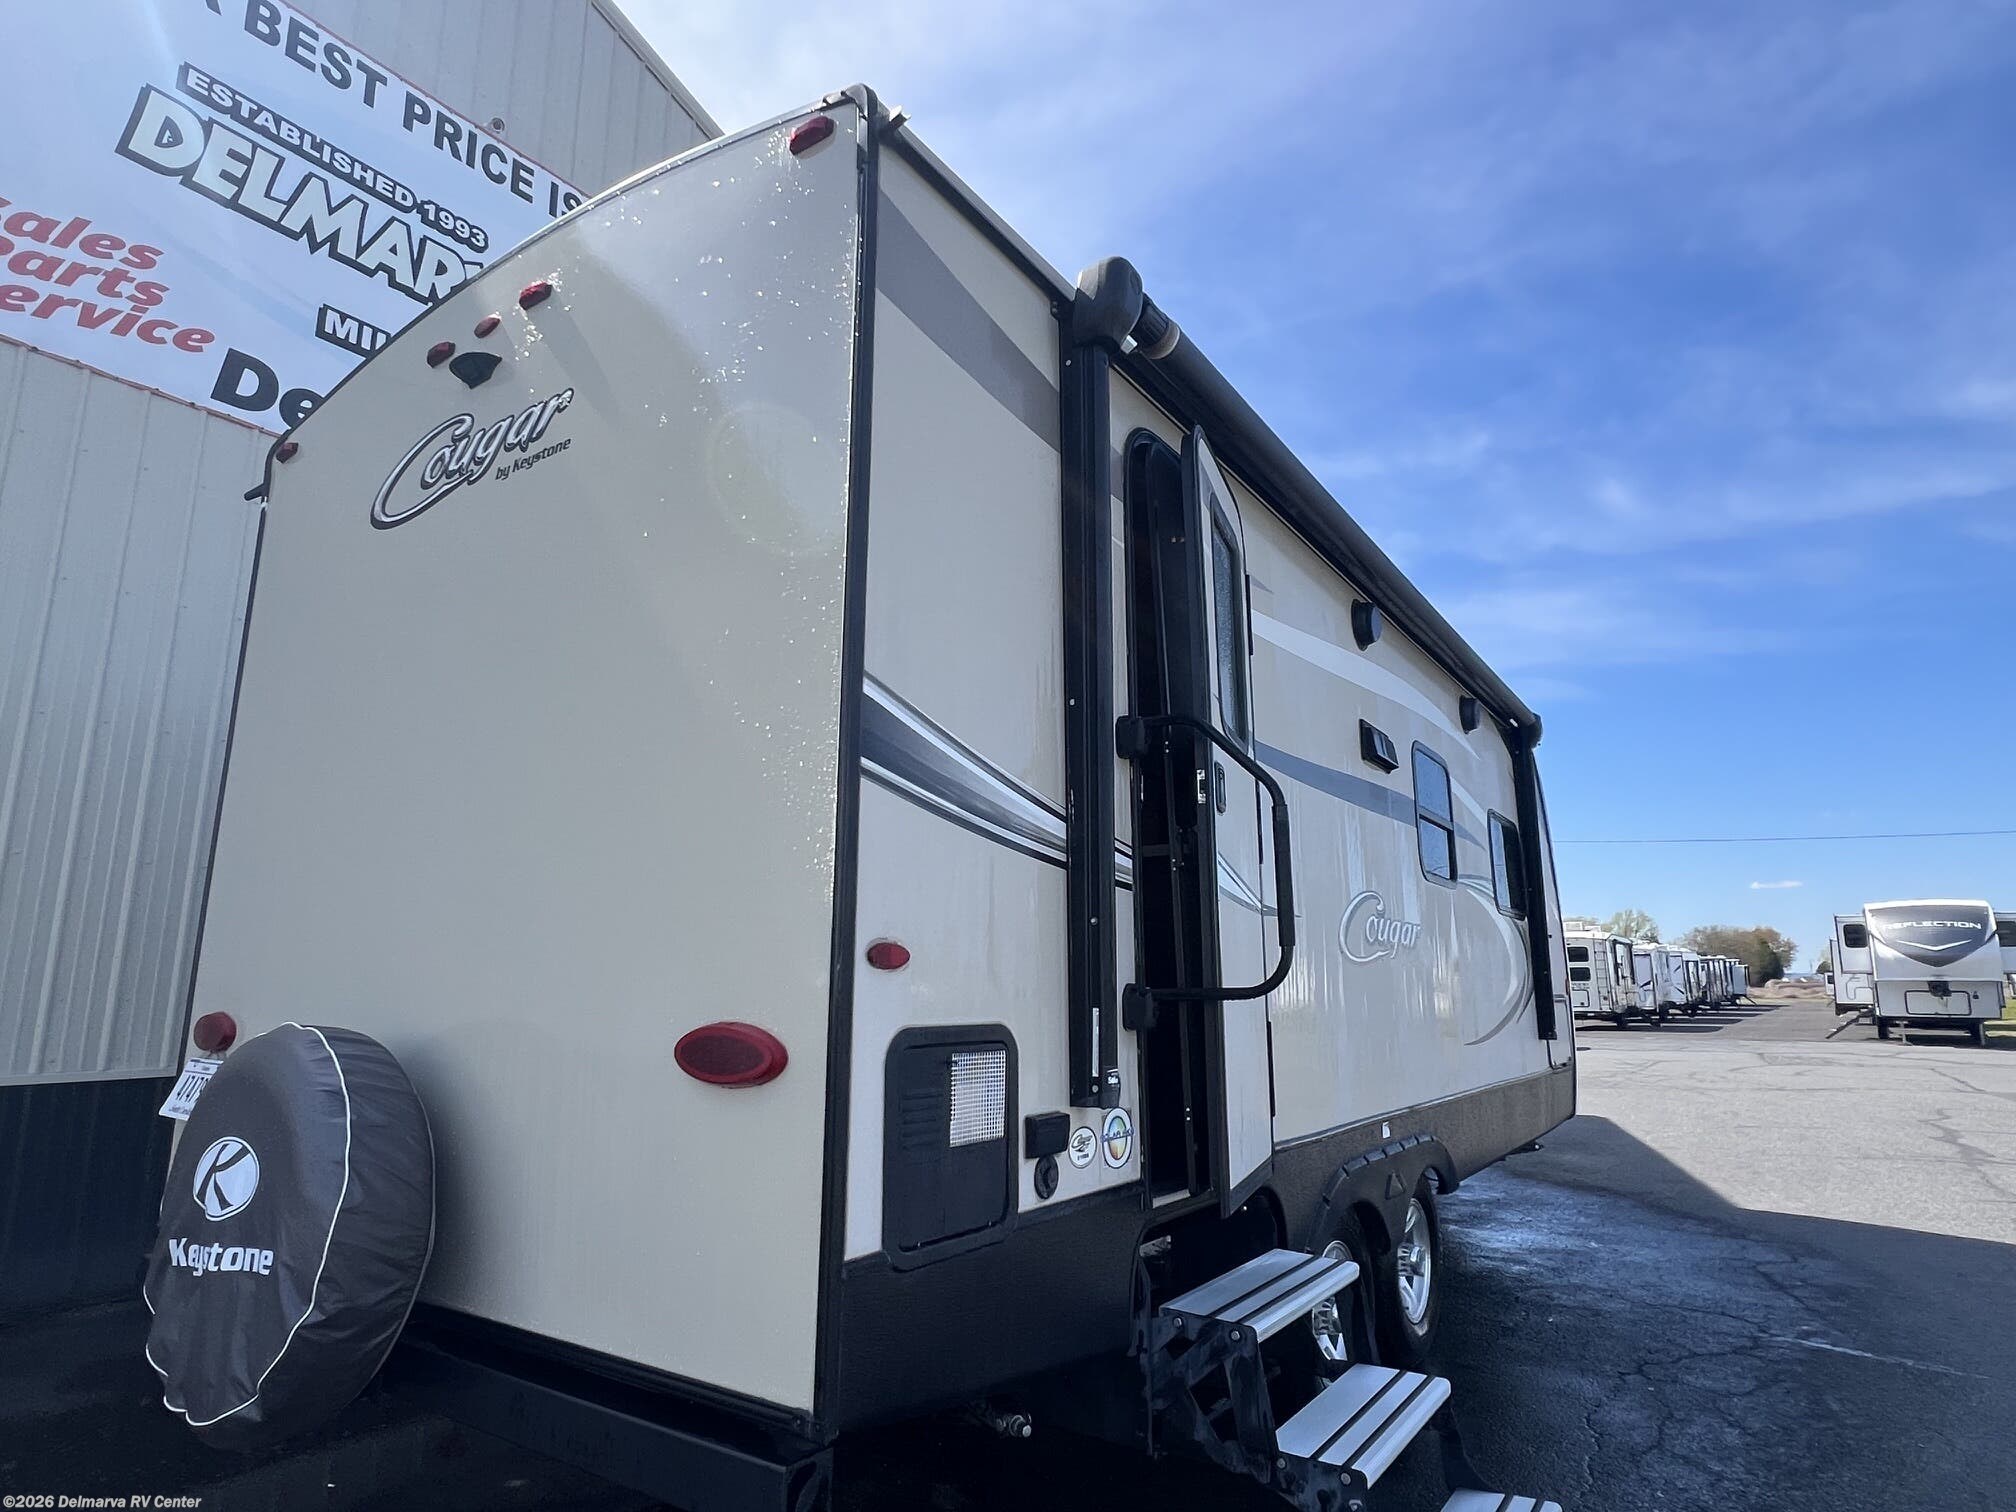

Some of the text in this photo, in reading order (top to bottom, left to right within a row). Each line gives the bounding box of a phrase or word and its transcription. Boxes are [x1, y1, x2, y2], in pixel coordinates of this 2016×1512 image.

[244, 0, 388, 109] BEST
[402, 90, 535, 204] PRICE
[122, 84, 482, 303] DELMAR
[186, 67, 487, 248] ESTABLISHED 1993
[0, 196, 165, 270] ales
[370, 388, 574, 530] Cougar
[495, 438, 571, 480] by Keystone
[1339, 891, 1421, 962] Cougar
[169, 1237, 274, 1276] Keystone
